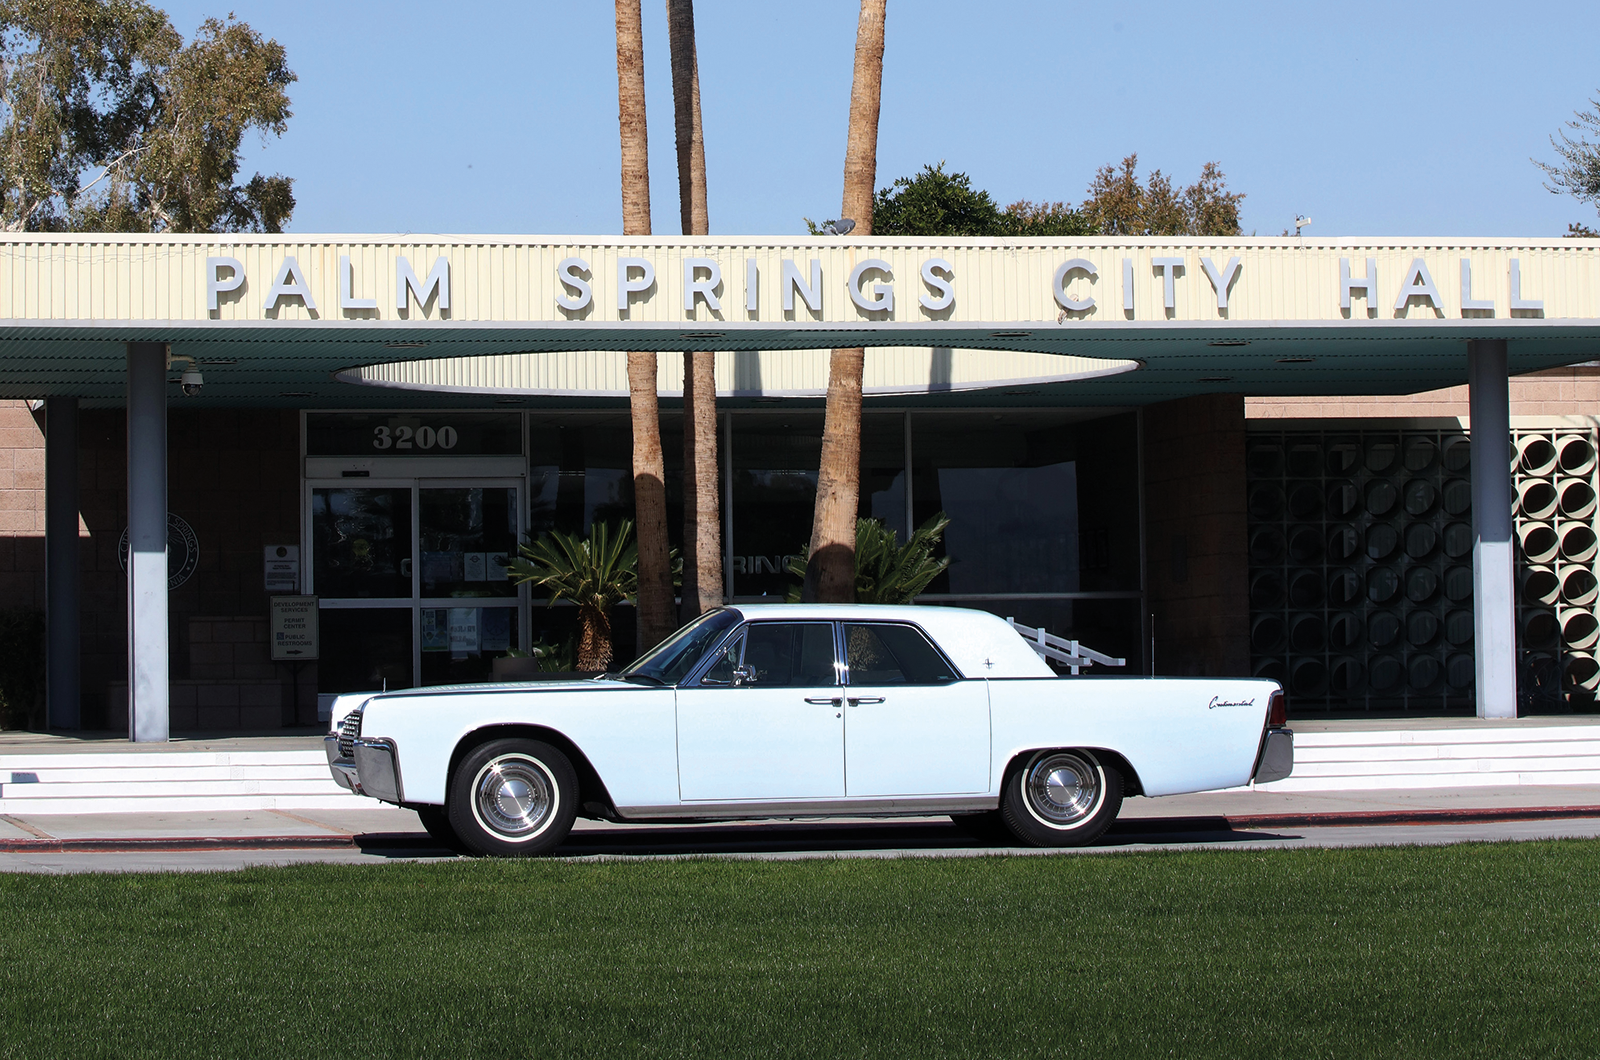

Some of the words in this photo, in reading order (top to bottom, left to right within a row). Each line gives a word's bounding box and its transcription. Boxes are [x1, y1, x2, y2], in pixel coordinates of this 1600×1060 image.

[206, 255, 450, 311] PALM
[555, 256, 955, 312] SPRINGS
[1053, 256, 1242, 312] CITY
[1339, 257, 1545, 310] HALL
[373, 425, 458, 450] 3200
[173, 518, 198, 553] SPRINGS
